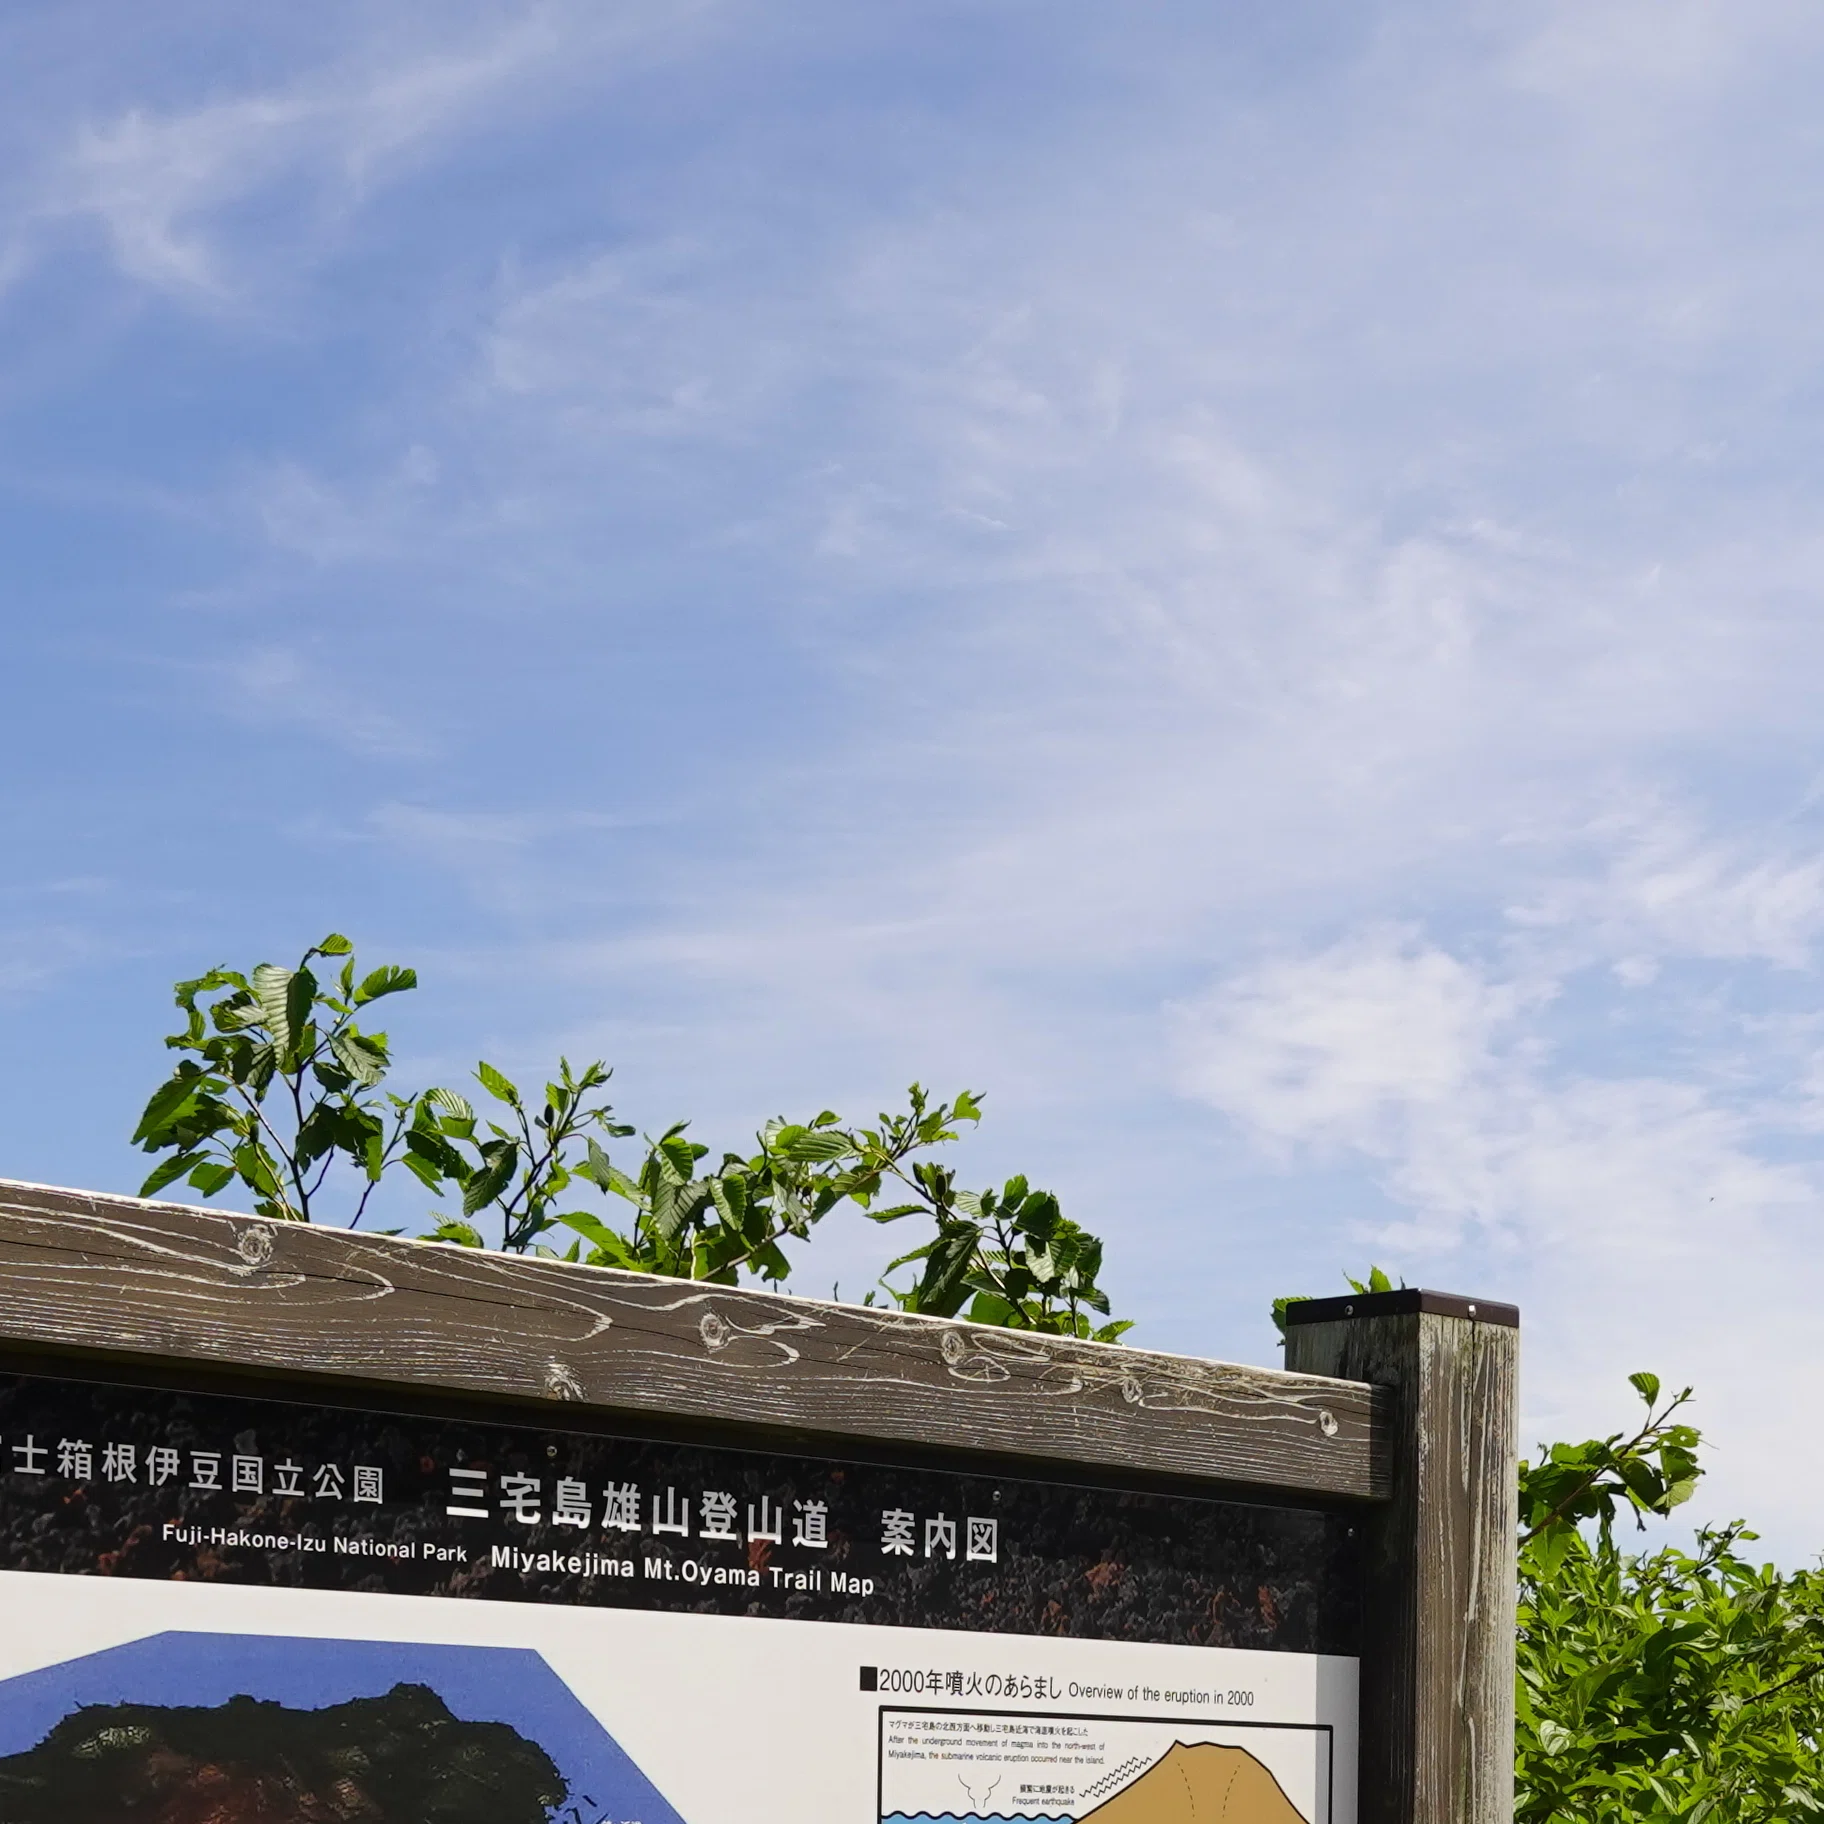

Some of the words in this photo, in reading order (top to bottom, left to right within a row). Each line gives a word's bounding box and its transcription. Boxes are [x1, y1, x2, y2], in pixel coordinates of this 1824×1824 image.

[446, 1468, 829, 1549] 三宅島雄山登山道
[880, 1507, 999, 1564] 案内図
[162, 1523, 326, 1553] Fuji-Hakone-Izu
[334, 1537, 416, 1559] National
[423, 1542, 468, 1564] Park
[491, 1544, 635, 1579] Miyakejima
[644, 1557, 760, 1588] Mt.Oyama
[770, 1566, 822, 1592] Trail
[831, 1571, 874, 1597] Map
[879, 1668, 1062, 1699] 2000年噴火のあらまし
[1069, 1682, 1123, 1700] Overview
[1127, 1685, 1139, 1701] of
[1143, 1686, 1160, 1701] the
[1164, 1688, 1210, 1705] eruption
[1214, 1689, 1223, 1705] in
[1227, 1690, 1254, 1706] 2000
